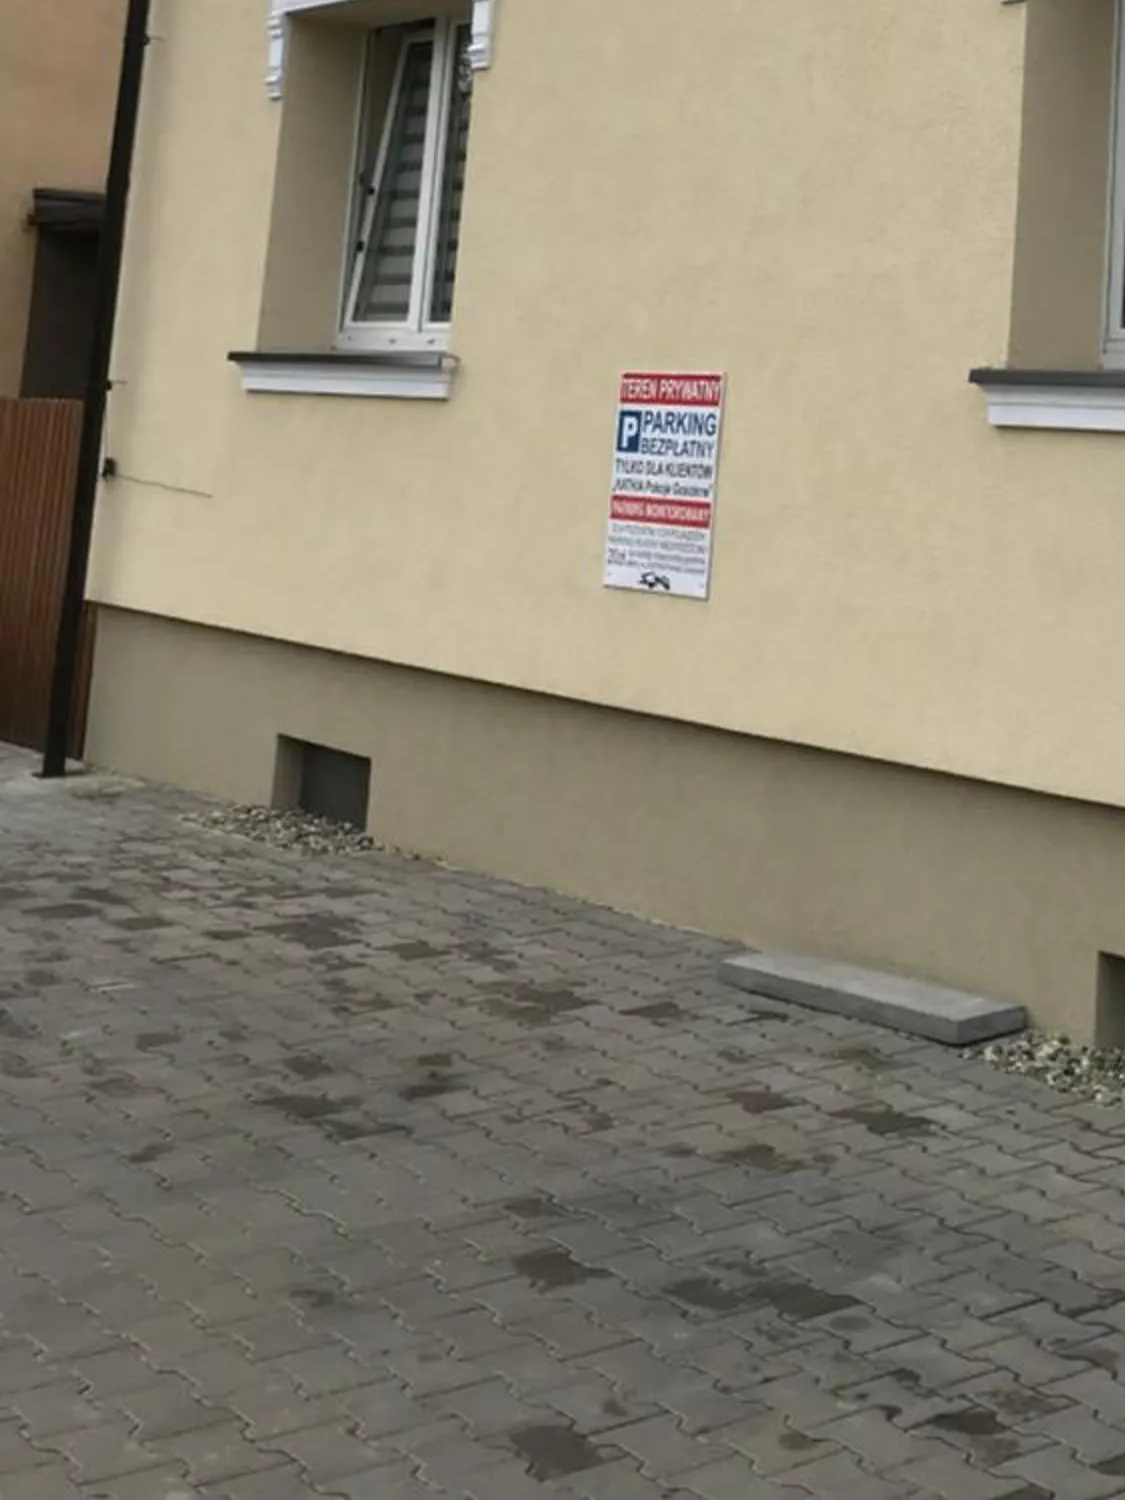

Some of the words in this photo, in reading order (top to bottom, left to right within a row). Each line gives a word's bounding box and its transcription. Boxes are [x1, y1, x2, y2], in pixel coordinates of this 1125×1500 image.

[621, 379, 656, 400] TEREN
[659, 379, 721, 403] PRYWATNY
[621, 416, 638, 448] P
[643, 410, 717, 436] PARKING
[641, 437, 714, 458] BEZPŁATNY
[616, 458, 644, 474] TYLKO
